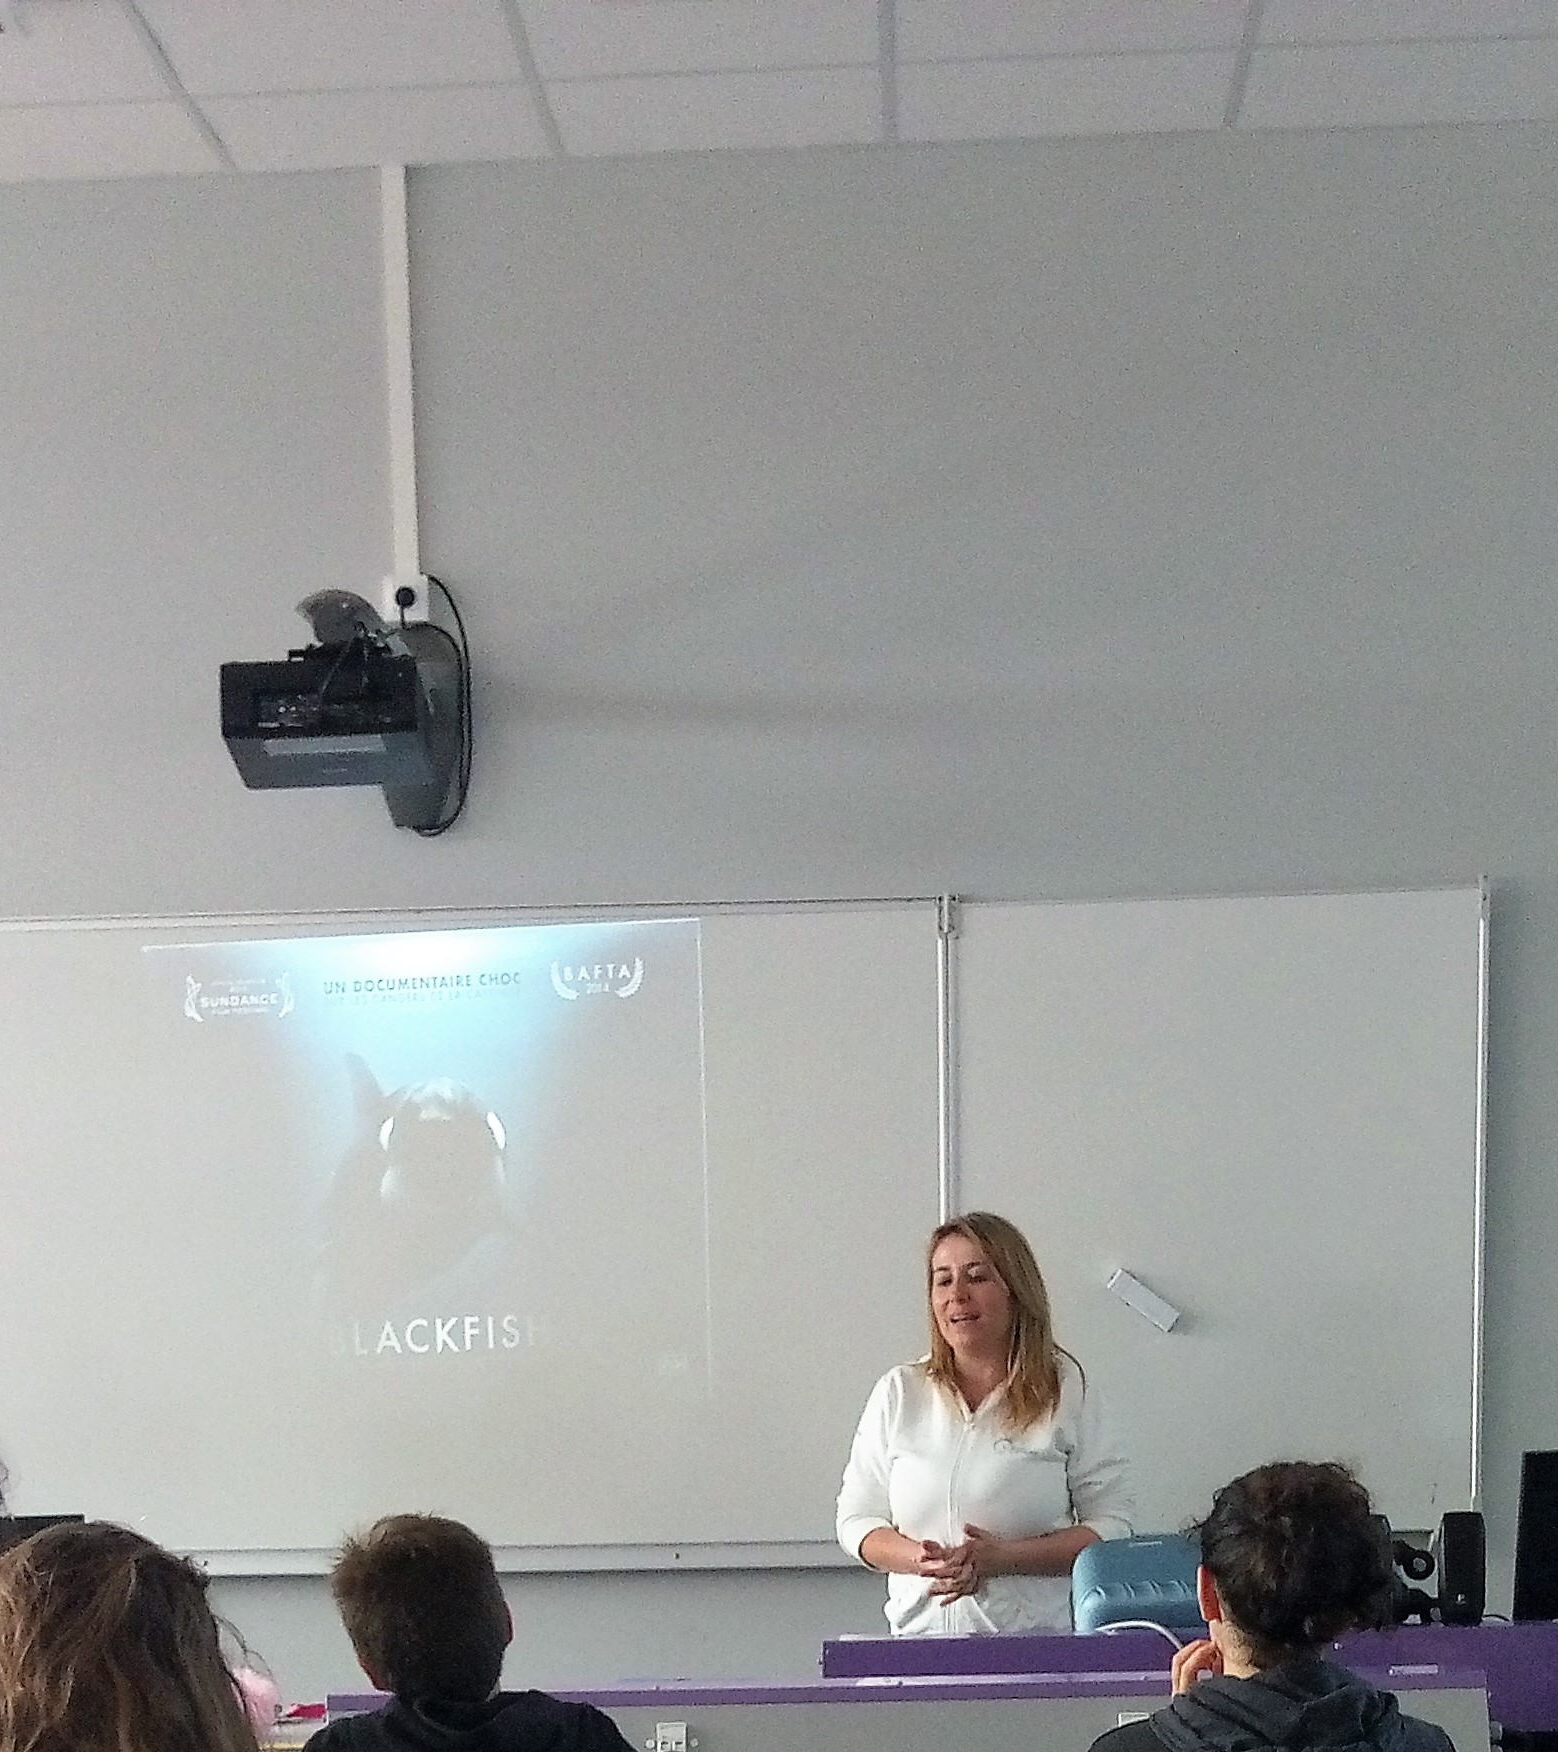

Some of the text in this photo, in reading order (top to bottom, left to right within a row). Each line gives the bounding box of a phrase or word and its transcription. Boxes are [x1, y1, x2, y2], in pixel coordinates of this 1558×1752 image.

[323, 981, 347, 995] UN
[353, 974, 472, 993] DOCUMENTAIRE
[478, 971, 521, 987] CHOC
[563, 963, 631, 982] BAFTA
[200, 992, 278, 1008] SUNDANCE
[327, 1312, 548, 1356] LACKFIS
